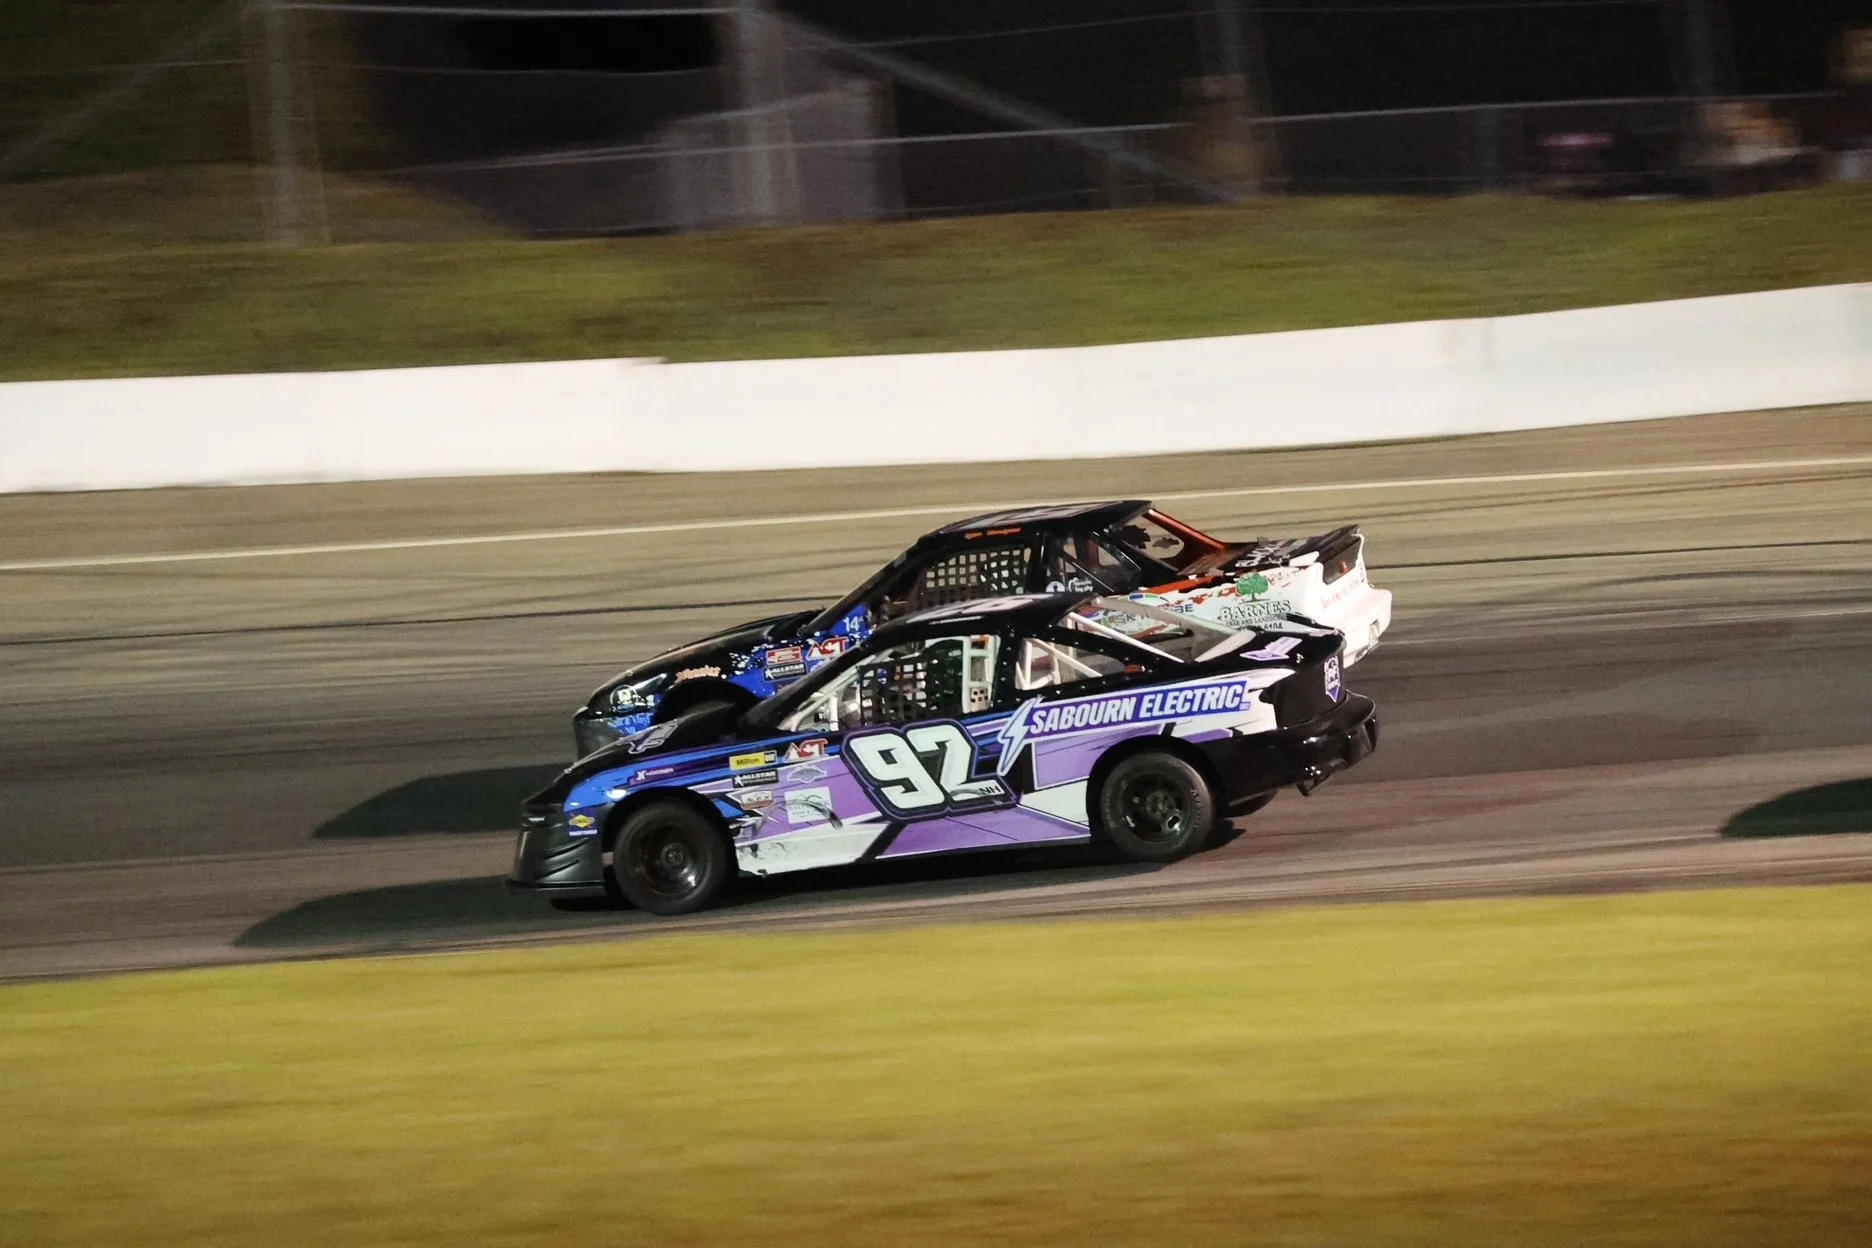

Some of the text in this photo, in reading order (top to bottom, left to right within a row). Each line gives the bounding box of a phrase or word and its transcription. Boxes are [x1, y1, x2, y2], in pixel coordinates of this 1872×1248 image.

[1219, 599, 1292, 621] BARNES
[1029, 684, 1244, 735] SABOURN ELECTRIC
[783, 738, 828, 763] ACT
[848, 723, 1006, 810] 92
[980, 785, 1002, 796] NH
